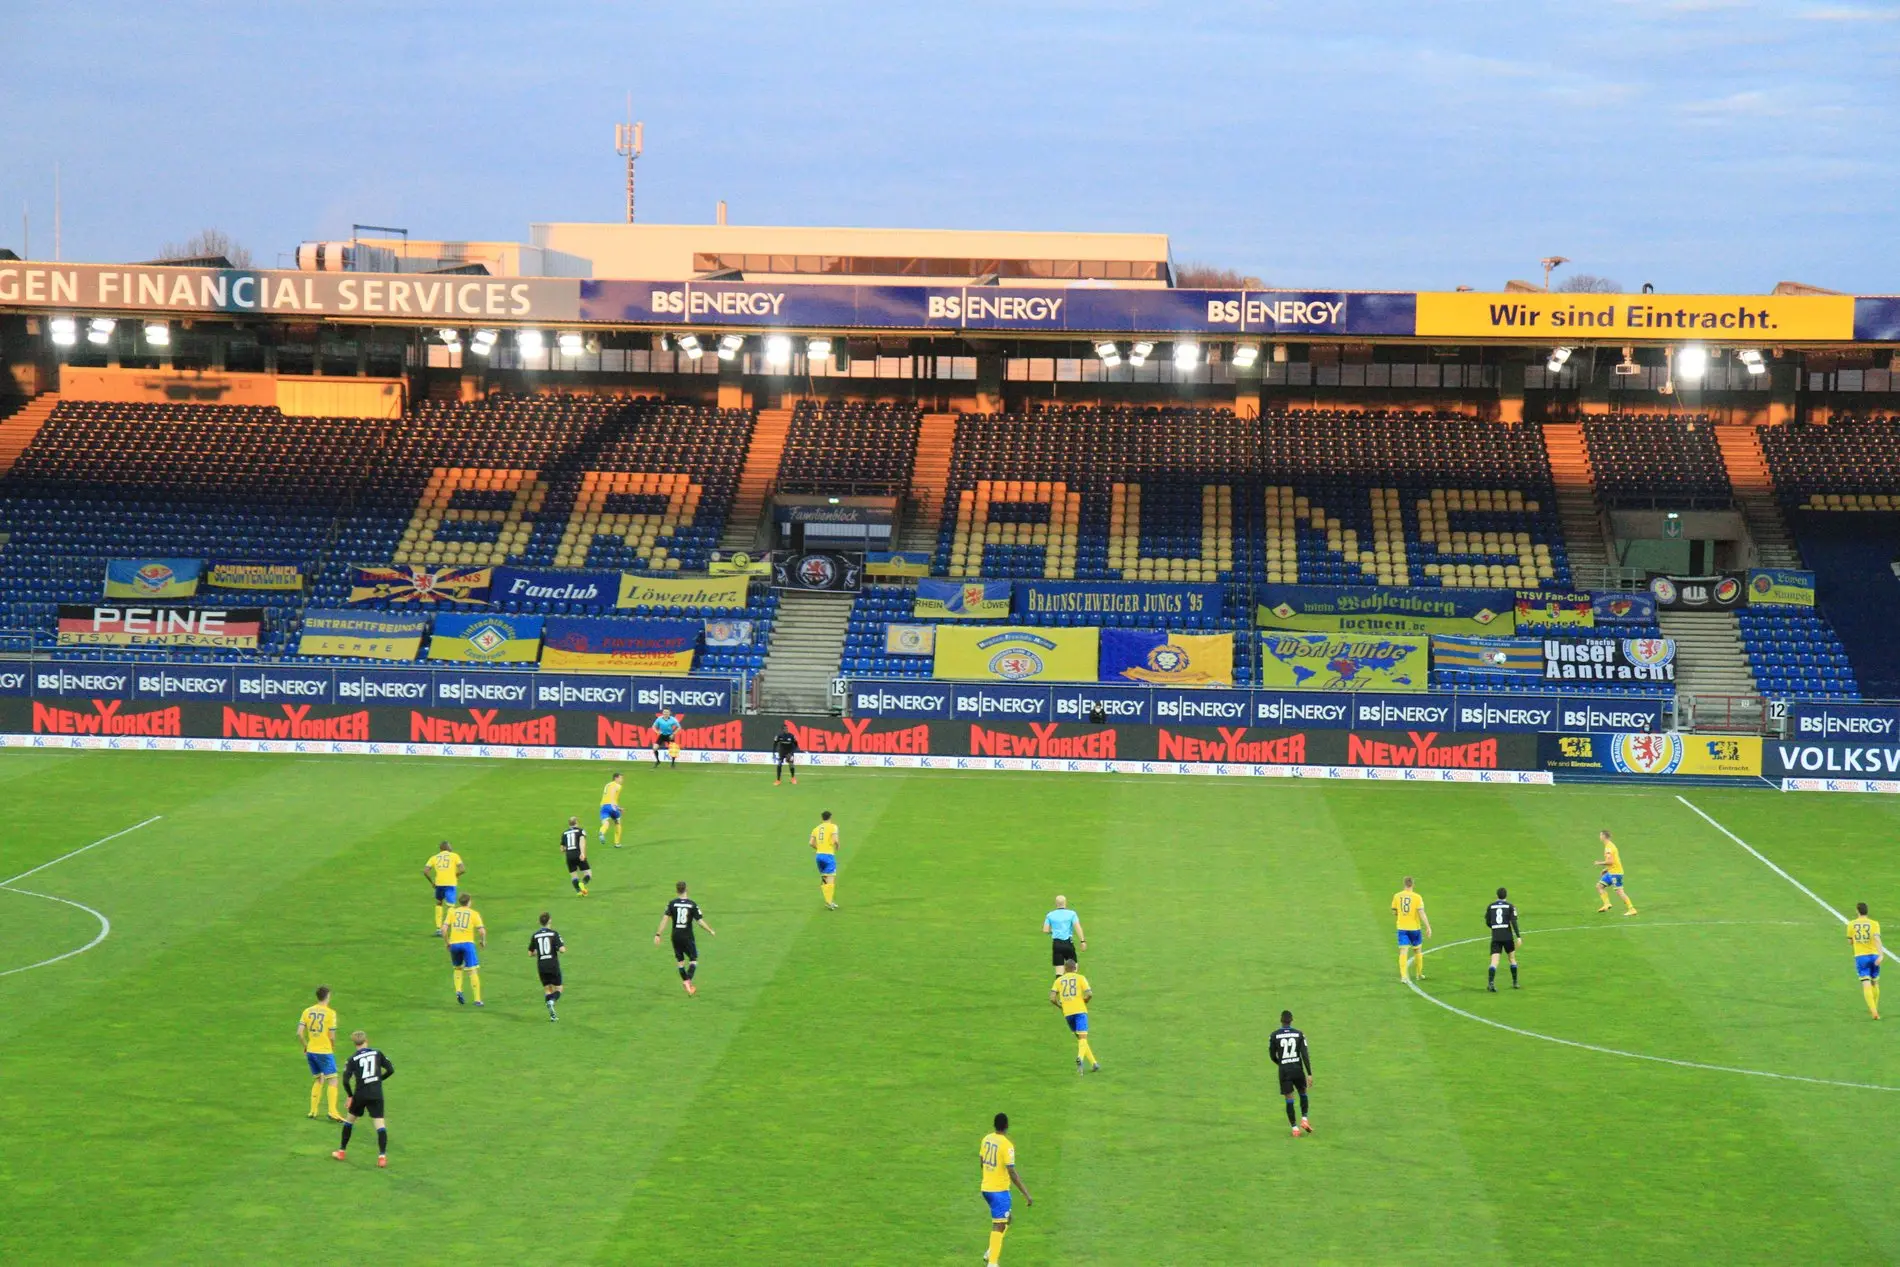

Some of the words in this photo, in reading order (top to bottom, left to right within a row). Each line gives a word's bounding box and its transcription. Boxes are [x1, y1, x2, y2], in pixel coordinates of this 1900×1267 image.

[0, 269, 77, 302] GEN
[100, 272, 322, 310] FINANCIAL
[338, 279, 531, 315] SERVICES
[1490, 304, 1537, 326] Wir
[1551, 304, 1614, 328] sind
[1627, 305, 1777, 329] Eintracht.
[508, 578, 598, 599] Fanclub
[626, 585, 736, 603] Löwenherz
[1545, 592, 1590, 602] Fan-Club
[915, 600, 943, 609] RHEIN
[1028, 588, 1140, 612] BRAUNSCHWEIGER
[1143, 592, 1182, 612] JUNGS
[93, 607, 227, 636] PEINE
[60, 632, 115, 644] BTSV
[130, 634, 251, 646] EINTRACHT
[1275, 642, 1342, 658] World
[1348, 641, 1407, 659] Wide
[1544, 640, 1615, 662] Unser
[832, 680, 846, 694] 13
[1770, 703, 1785, 718] 12
[565, 833, 577, 847] 11
[435, 855, 450, 868] 25
[1400, 896, 1411, 913] 18
[453, 911, 470, 928] 30
[676, 907, 688, 924] 18
[1496, 908, 1503, 924] 8
[1854, 923, 1870, 940] 33
[538, 937, 551, 955] 10
[1061, 979, 1077, 997] 28
[308, 1012, 325, 1032] 23
[1280, 1037, 1297, 1058] 22
[359, 1055, 376, 1079] 27
[983, 1141, 998, 1167] 20
